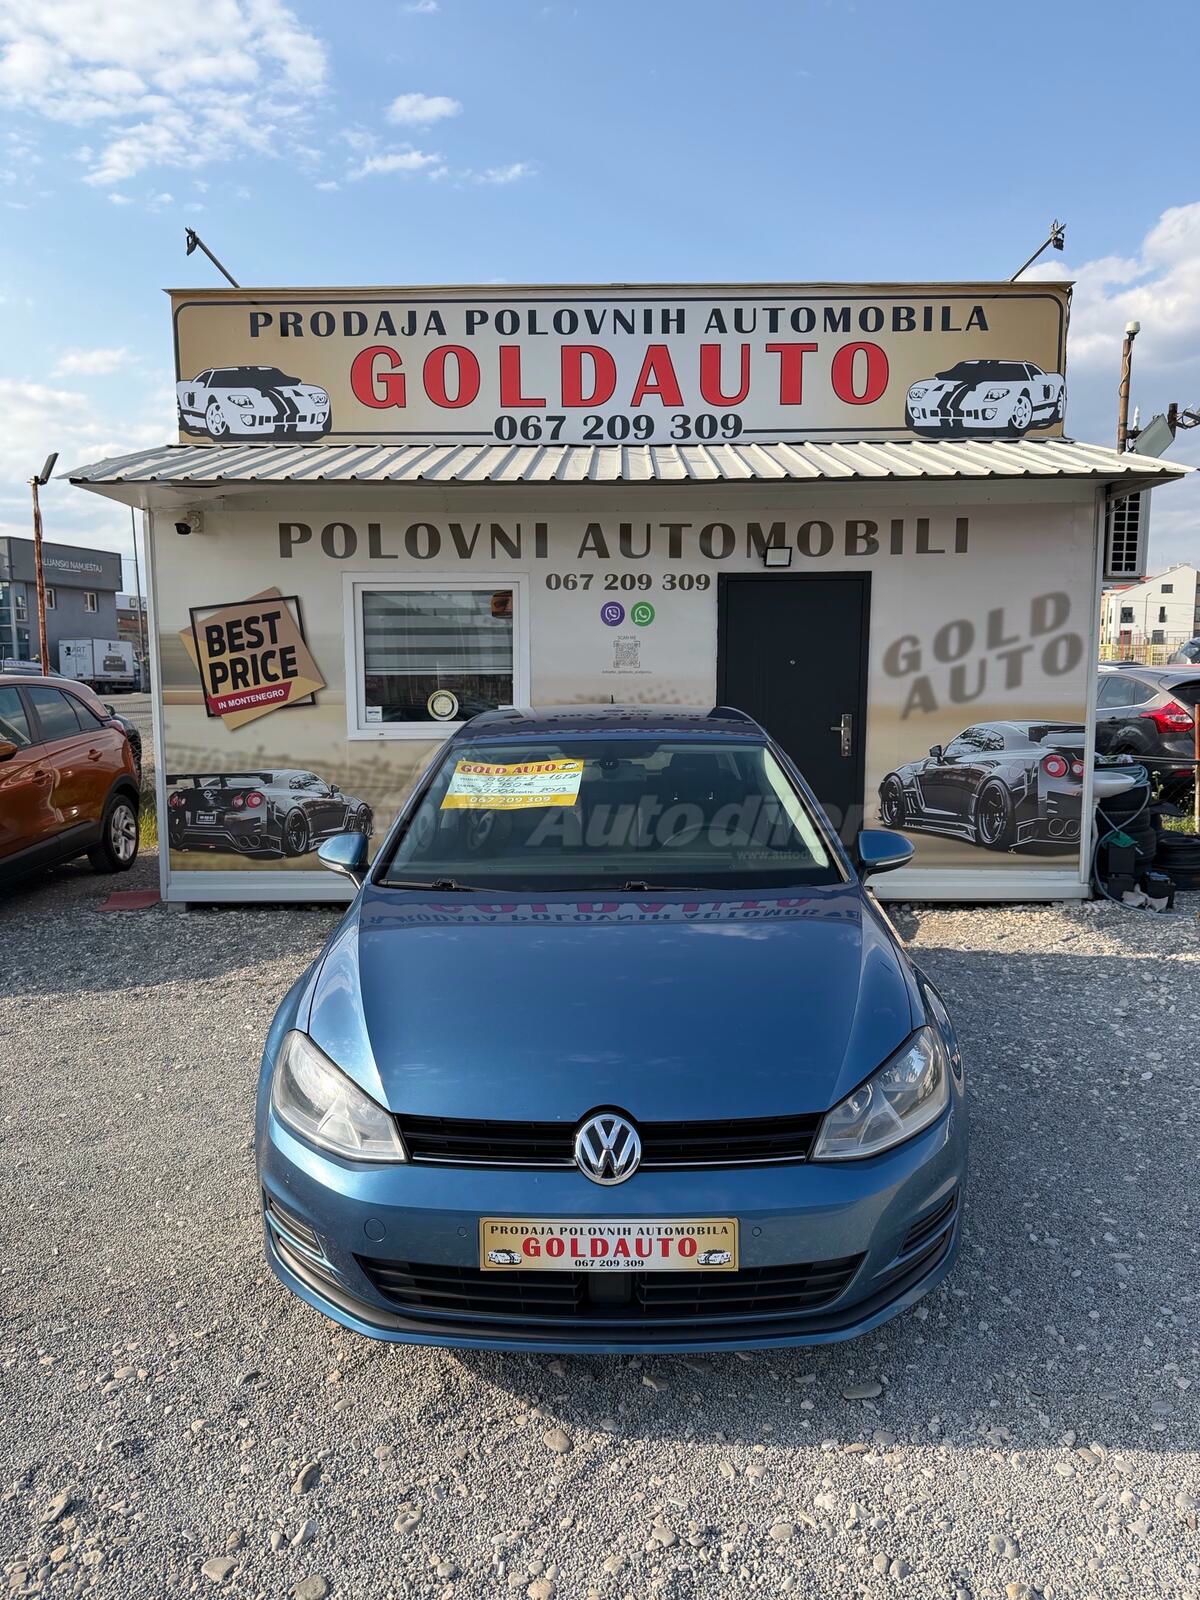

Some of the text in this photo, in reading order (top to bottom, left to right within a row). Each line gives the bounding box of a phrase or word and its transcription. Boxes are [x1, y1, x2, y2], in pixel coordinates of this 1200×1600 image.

[249, 305, 989, 338] PRODAJA POLOVNIH AUTOMOBILA
[350, 341, 890, 410] GOLDAUTO
[493, 413, 744, 441] 067 209 309
[278, 517, 969, 560] POLOVNI AUTOMOBILI
[545, 573, 711, 591] 067 209 309
[205, 610, 281, 658] BEST
[882, 591, 1072, 678] GOLD
[208, 645, 298, 695] PRICE
[901, 631, 1083, 721] AUTO
[218, 688, 285, 710] IN MONTENEGRO
[461, 763, 557, 774] GOLD AUTO
[490, 1225, 729, 1236] PRODAJA POLOVNIH AUTOMOBILA
[522, 1237, 698, 1258] GOLDAUTO
[574, 1259, 645, 1267] 067 209 309
